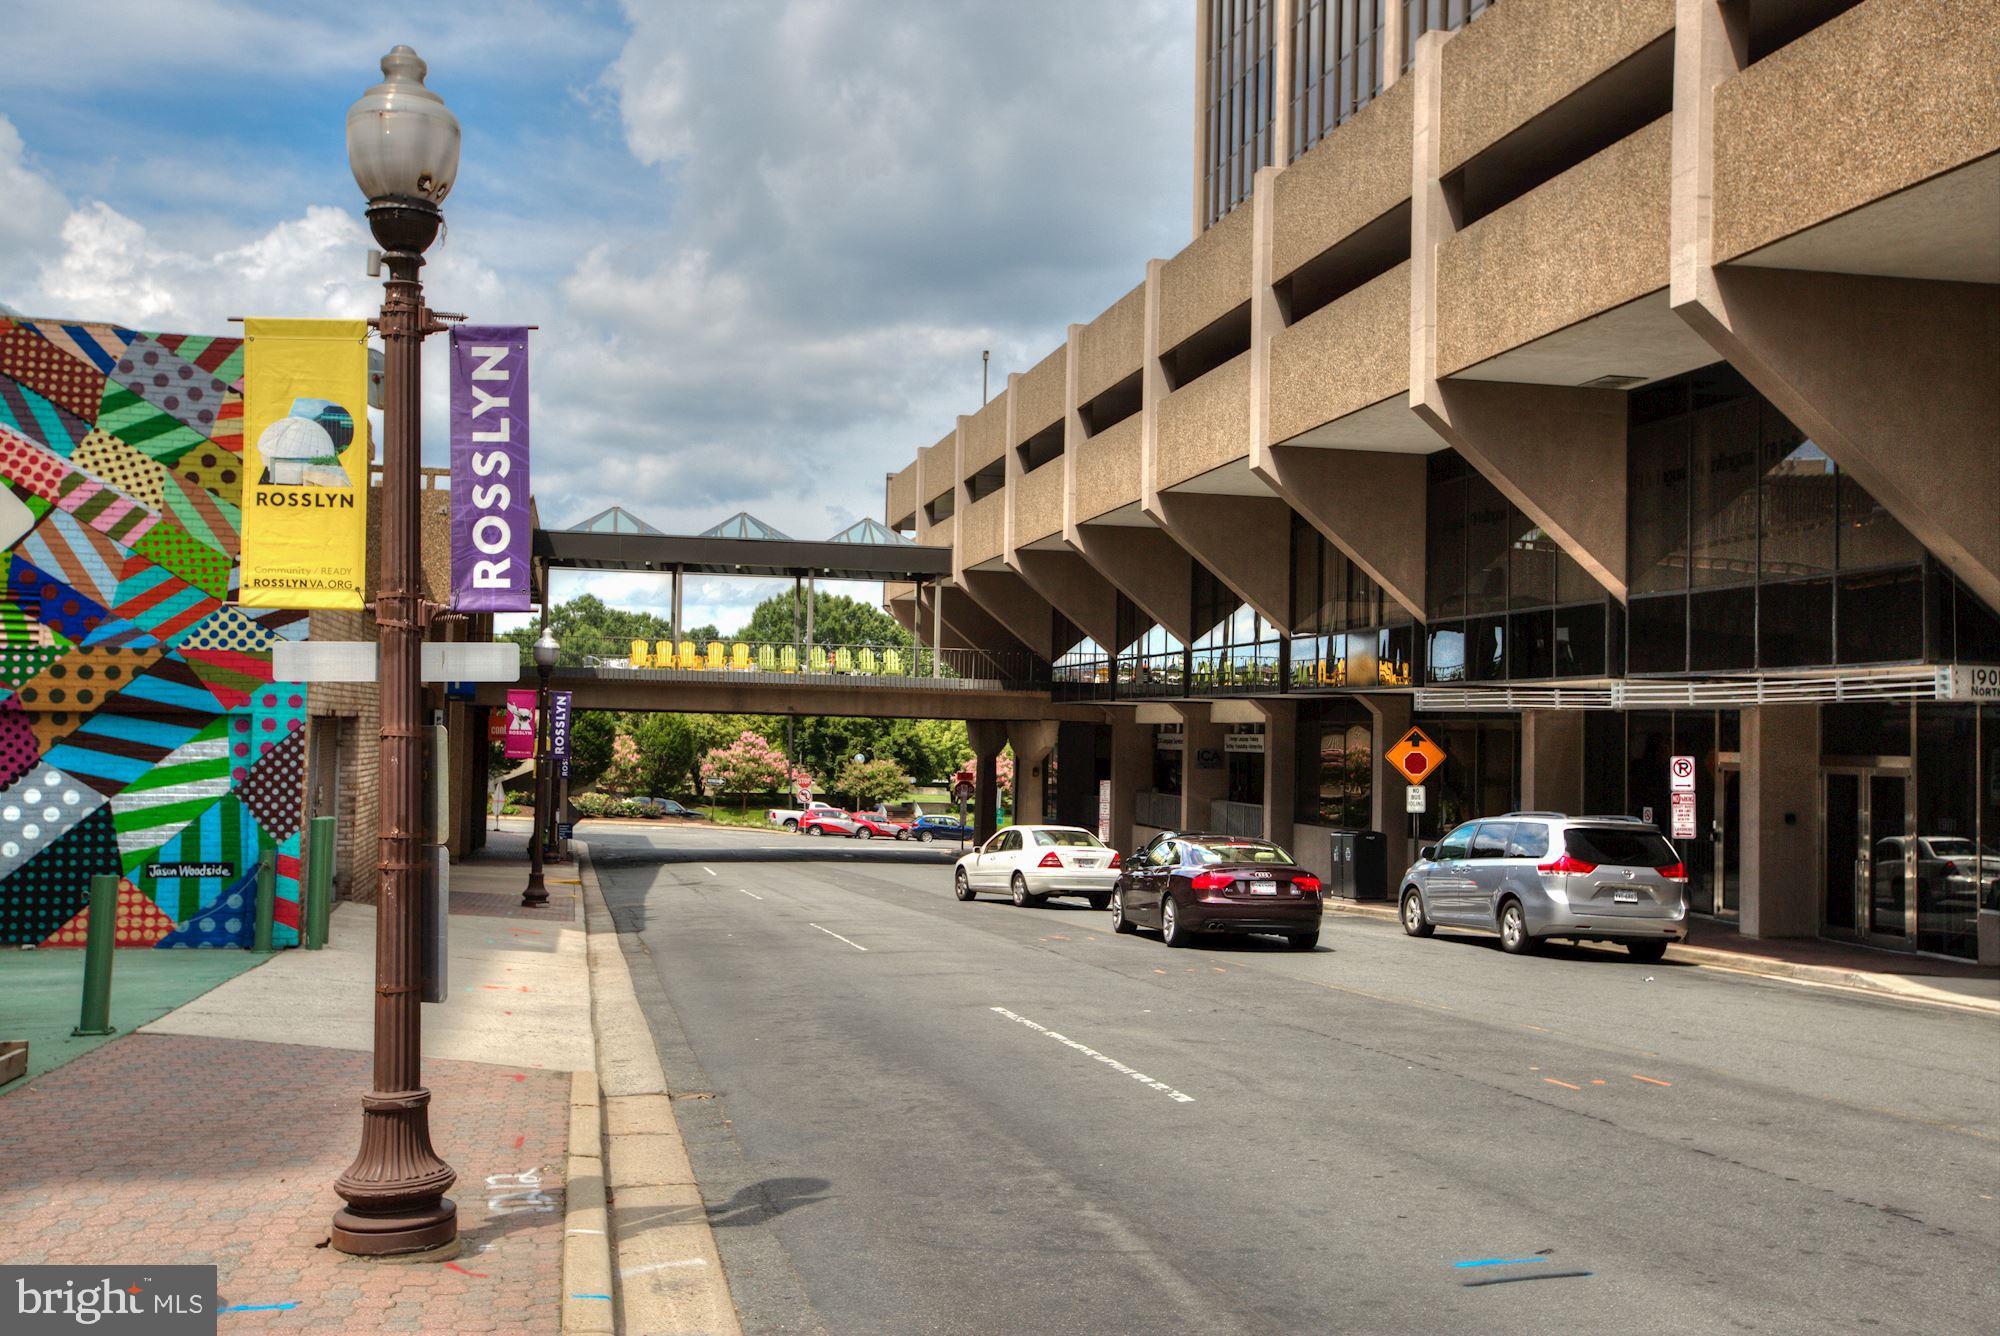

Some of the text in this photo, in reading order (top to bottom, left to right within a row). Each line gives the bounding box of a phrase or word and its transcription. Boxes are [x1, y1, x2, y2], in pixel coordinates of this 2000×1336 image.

[471, 346, 511, 589] ROSSLYN
[256, 491, 354, 508] ROSSLYN
[254, 566, 312, 576] Community
[320, 567, 353, 576] READY
[554, 695, 567, 755] ROSSLYN
[561, 758, 569, 777] ROS
[149, 864, 231, 878] Jason Woodside
